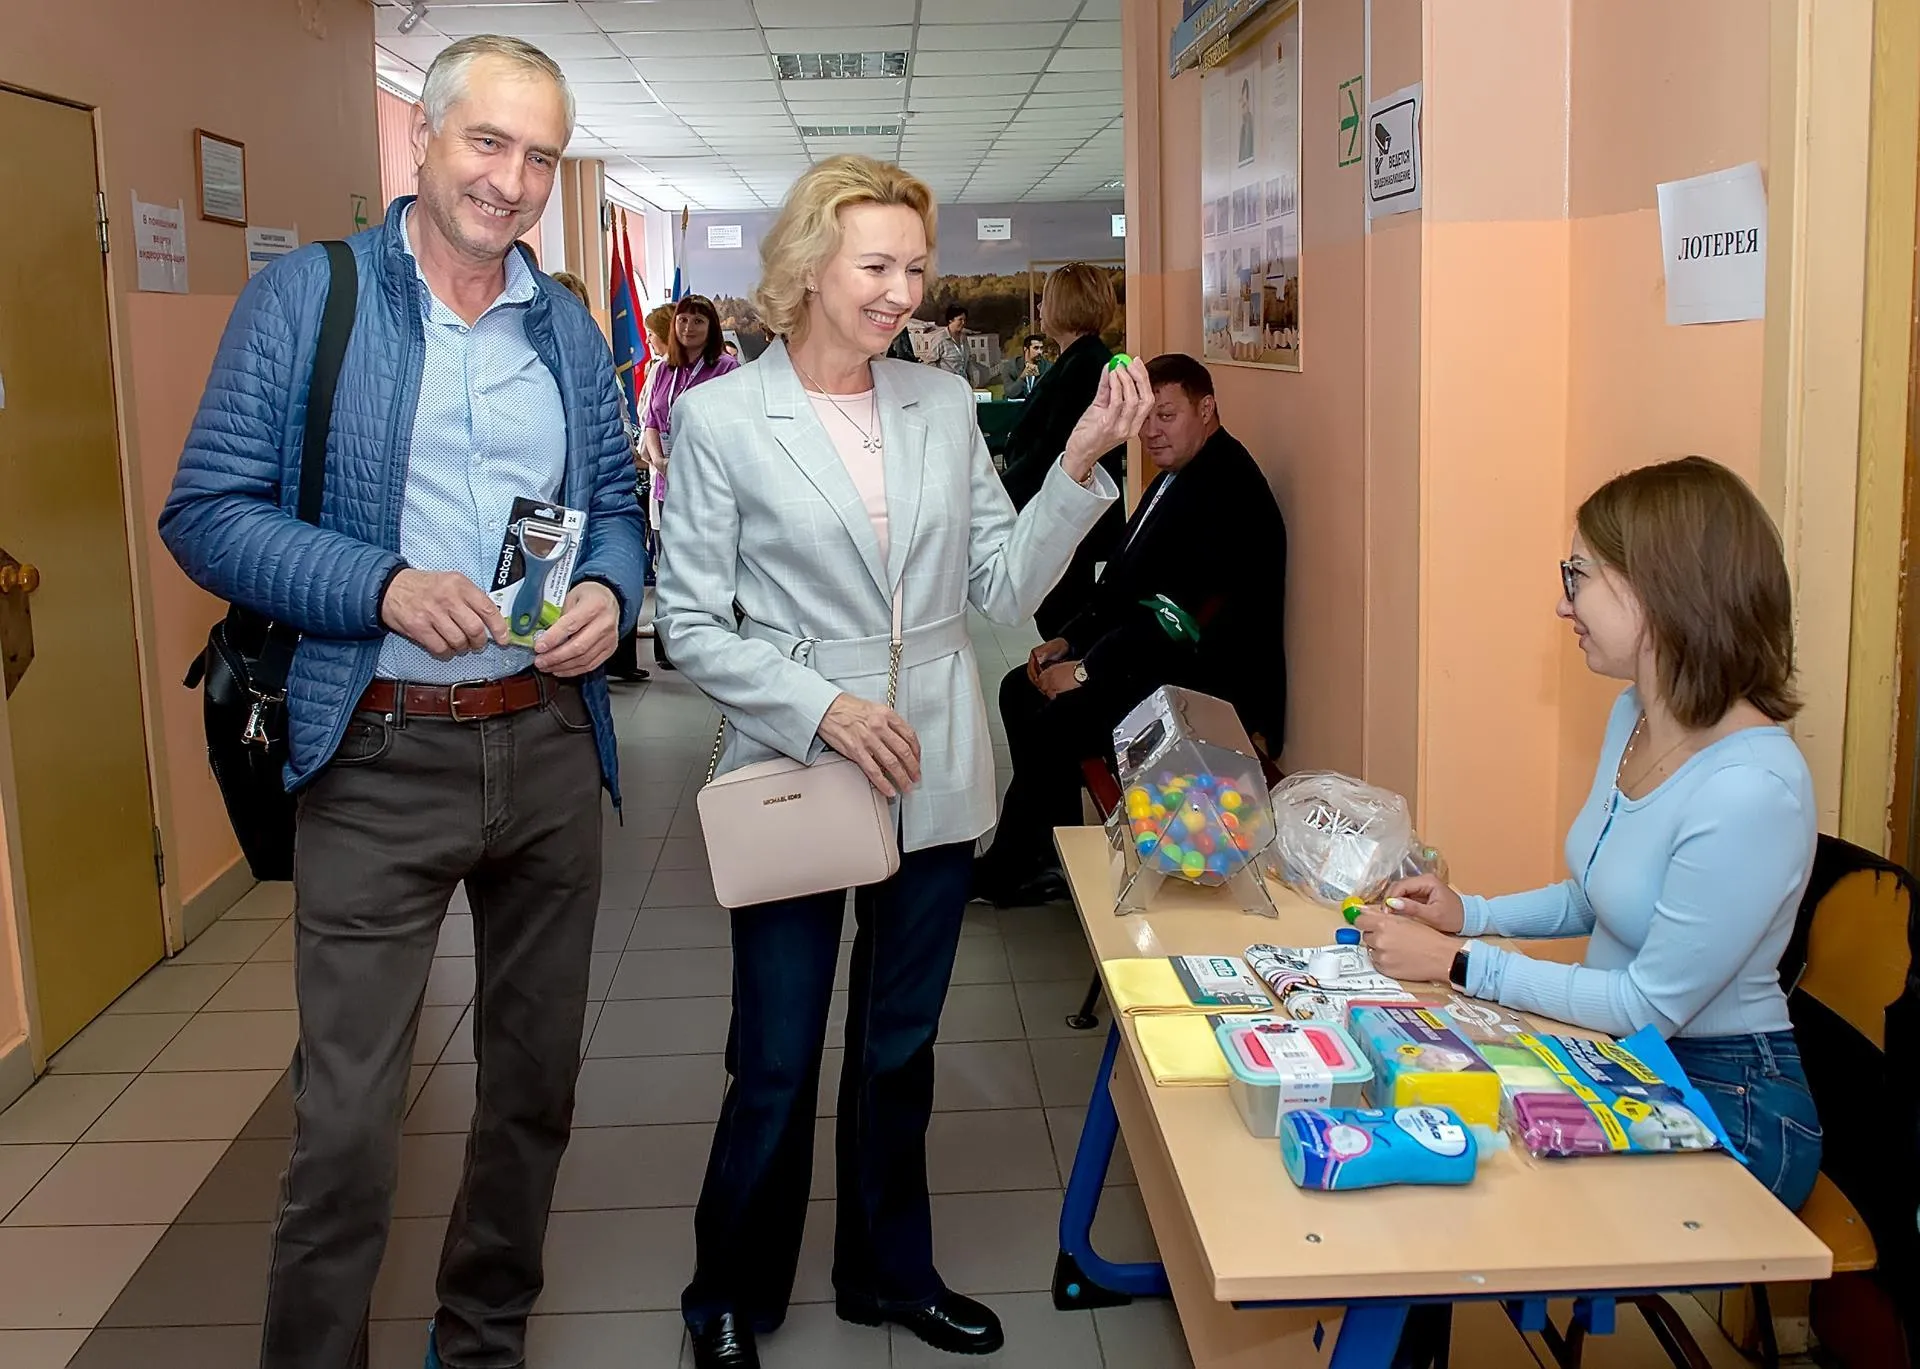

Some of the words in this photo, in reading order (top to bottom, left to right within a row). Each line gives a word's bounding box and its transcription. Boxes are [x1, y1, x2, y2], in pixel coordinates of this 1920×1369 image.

[1678, 227, 1758, 261] ЛОТЕРЕЯ
[568, 516, 577, 524] 24
[498, 543, 516, 586] satoshi
